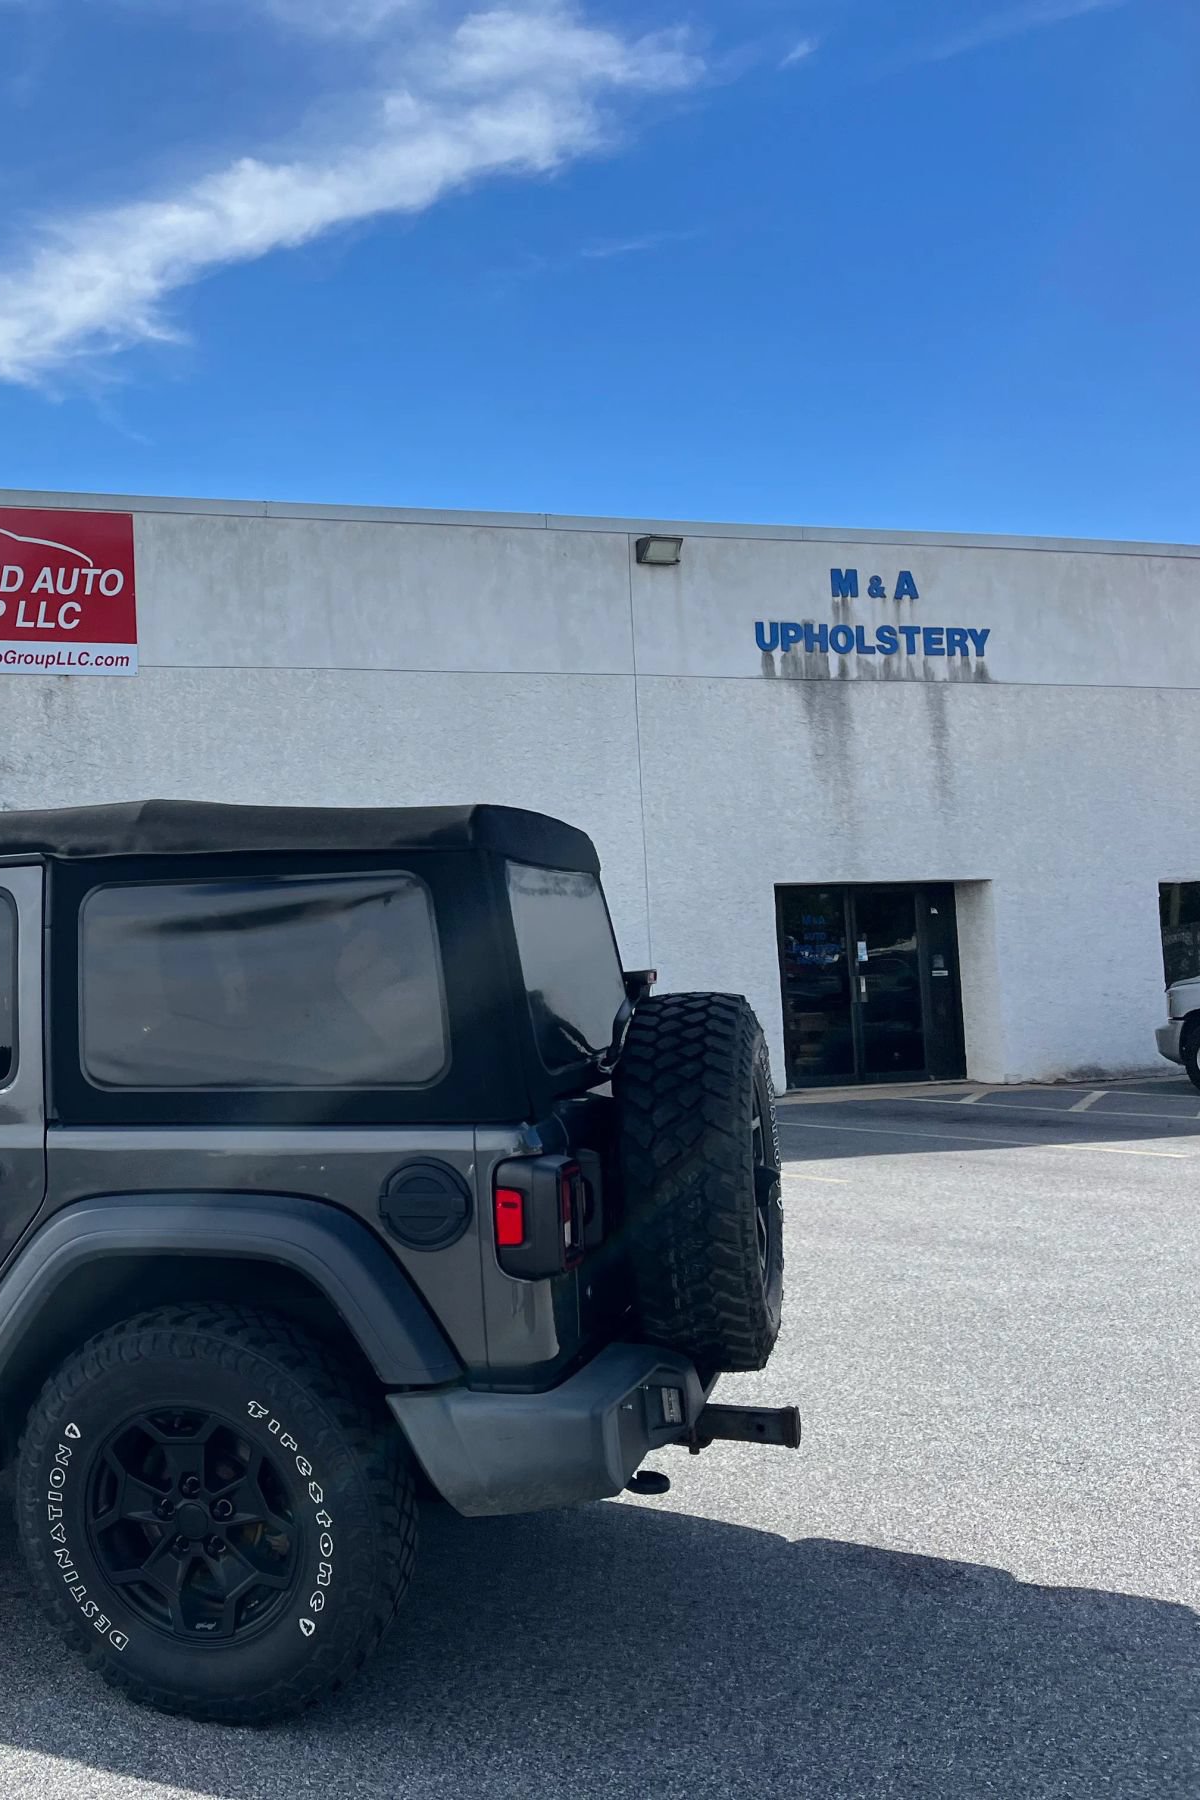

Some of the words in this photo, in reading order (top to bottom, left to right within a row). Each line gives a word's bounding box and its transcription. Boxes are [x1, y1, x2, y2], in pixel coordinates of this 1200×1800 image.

[30, 567, 125, 597] AUTO
[829, 568, 859, 598] M
[866, 575, 887, 599] &
[893, 570, 920, 600] A
[14, 600, 83, 630] LLC
[754, 621, 991, 657] UPHOLSTERY
[47, 1443, 130, 1652] DESTINATION
